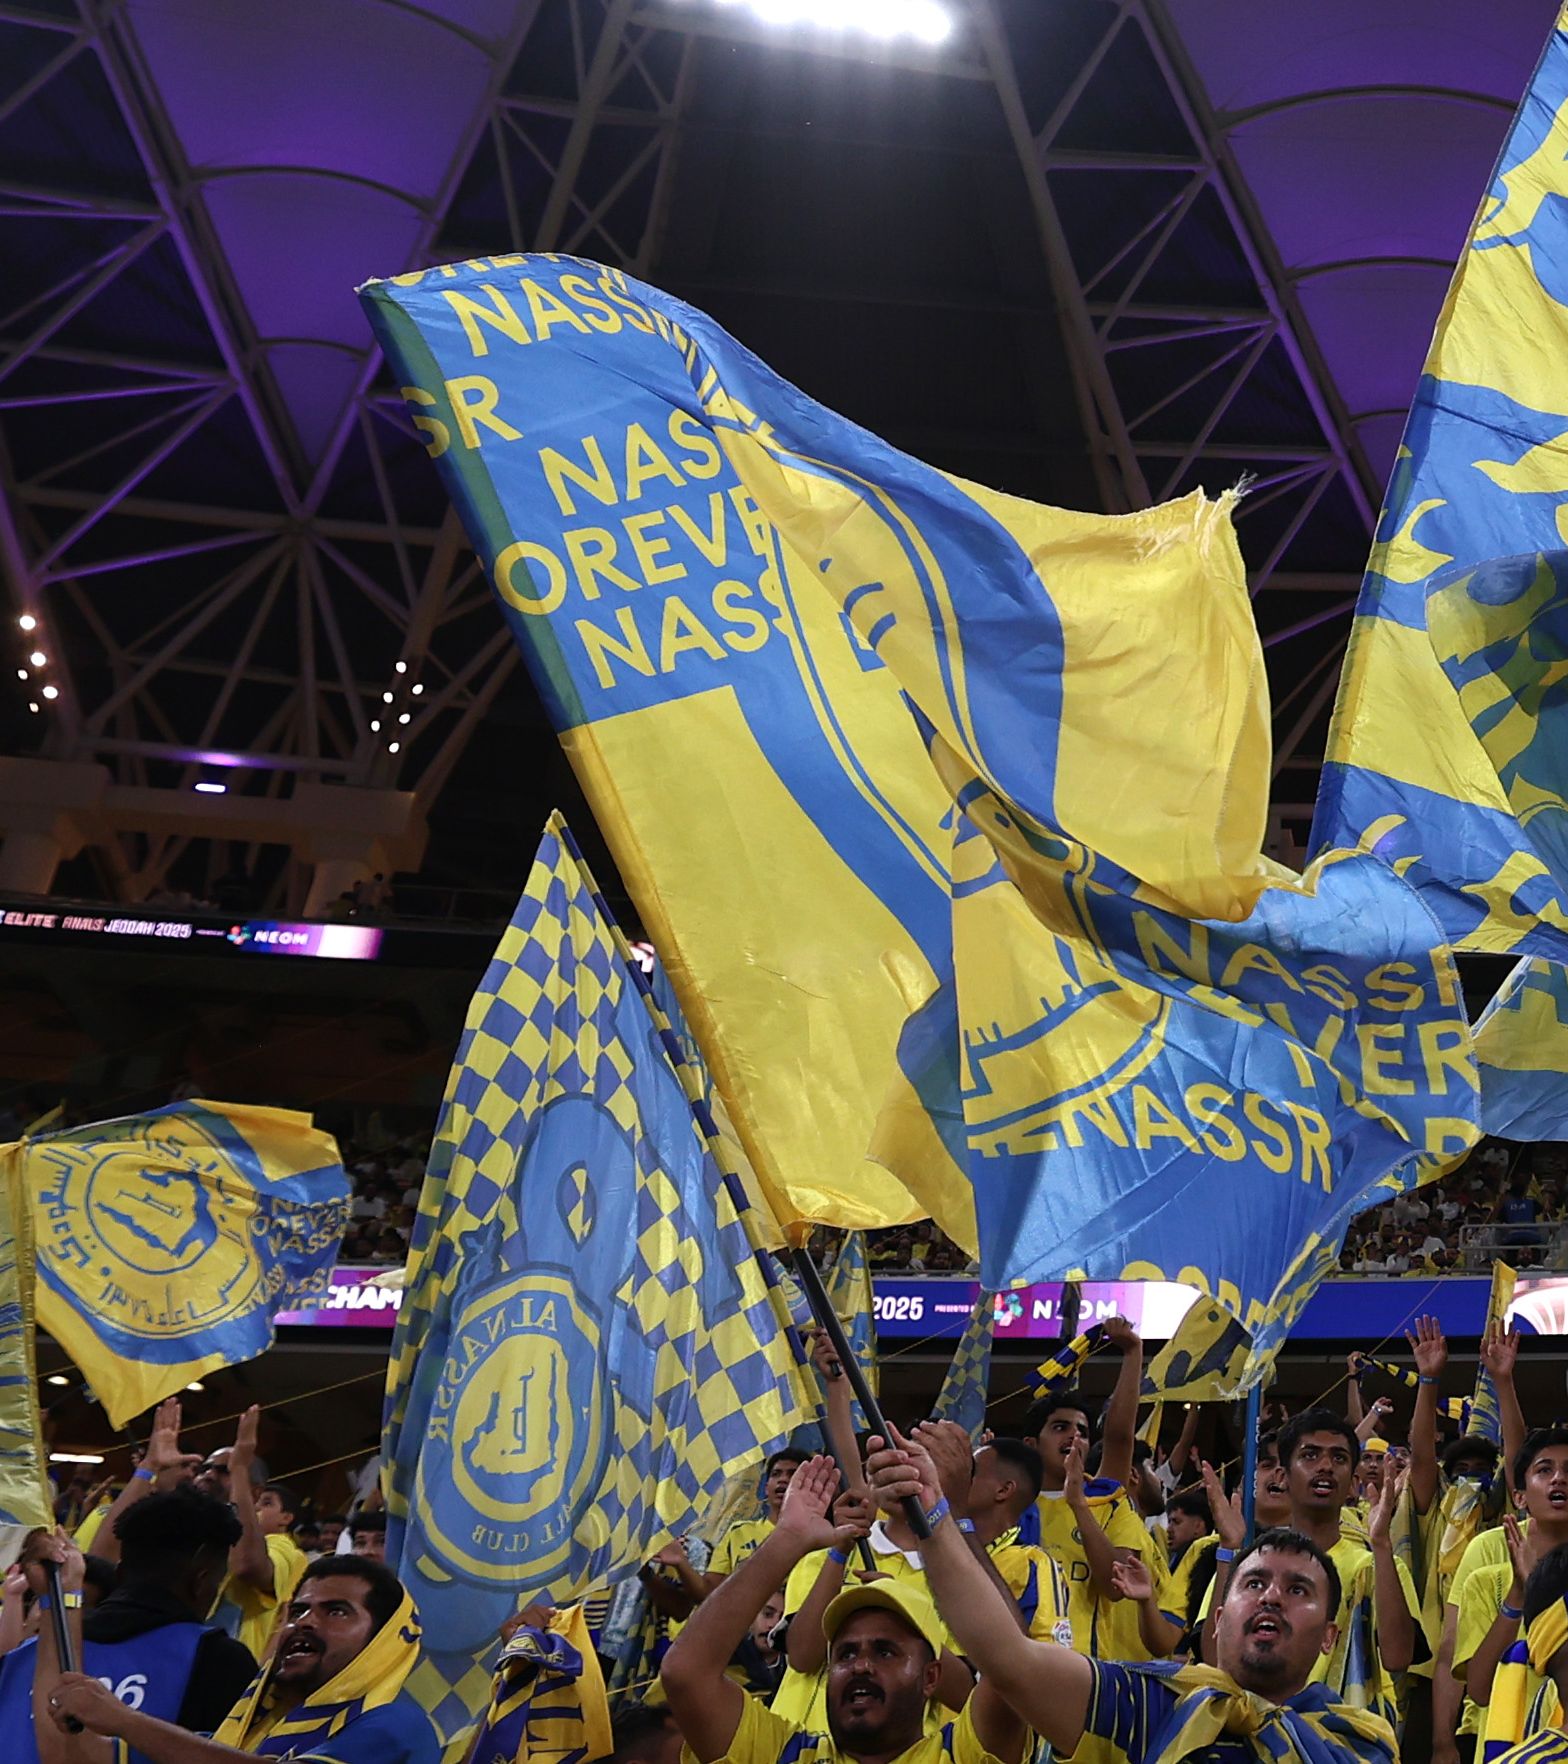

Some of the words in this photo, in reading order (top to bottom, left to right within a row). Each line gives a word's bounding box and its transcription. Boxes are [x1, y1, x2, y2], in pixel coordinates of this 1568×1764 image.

[440, 273, 668, 357] NASS
[4, 911, 56, 928] ELITE
[62, 916, 103, 932] FINALS
[103, 917, 153, 936] JEDDAH
[155, 921, 192, 939] 2025
[254, 930, 309, 946] NEOM
[1058, 1081, 1332, 1194] NASSR
[873, 1296, 924, 1321] 2025
[1033, 1299, 1118, 1320] NOM
